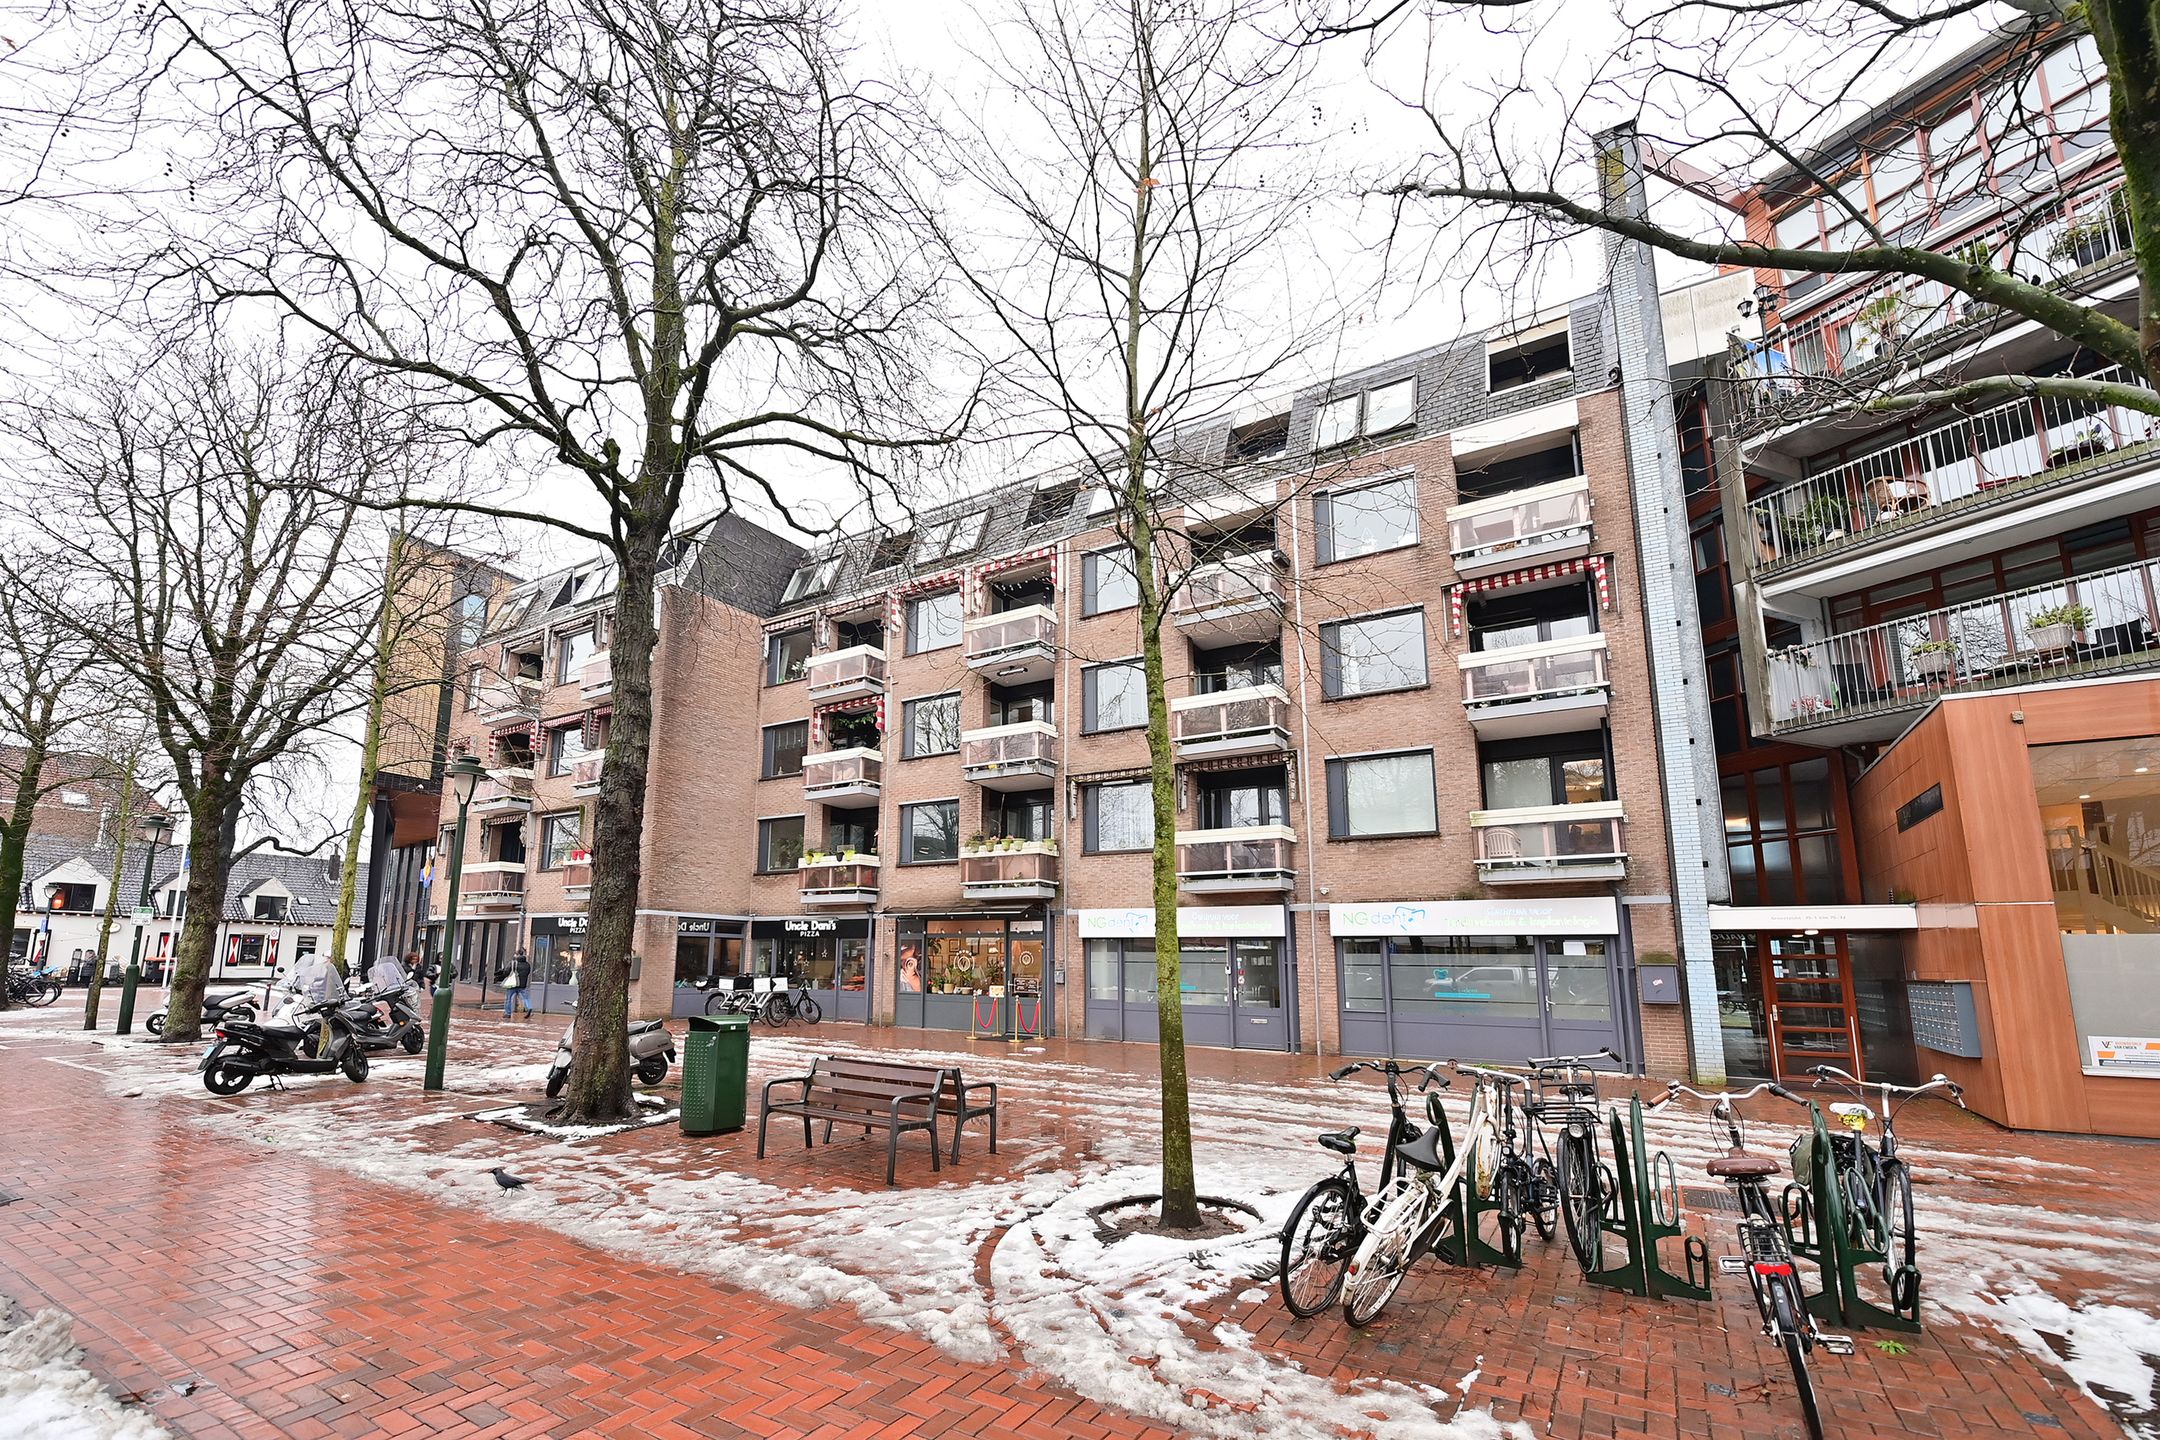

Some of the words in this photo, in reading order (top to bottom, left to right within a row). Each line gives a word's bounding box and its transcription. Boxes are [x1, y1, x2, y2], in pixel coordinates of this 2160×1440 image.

[430, 904, 438, 916] 73
[557, 917, 578, 928] Uncle
[784, 920, 809, 931] Uncle
[810, 920, 837, 931] Dani's
